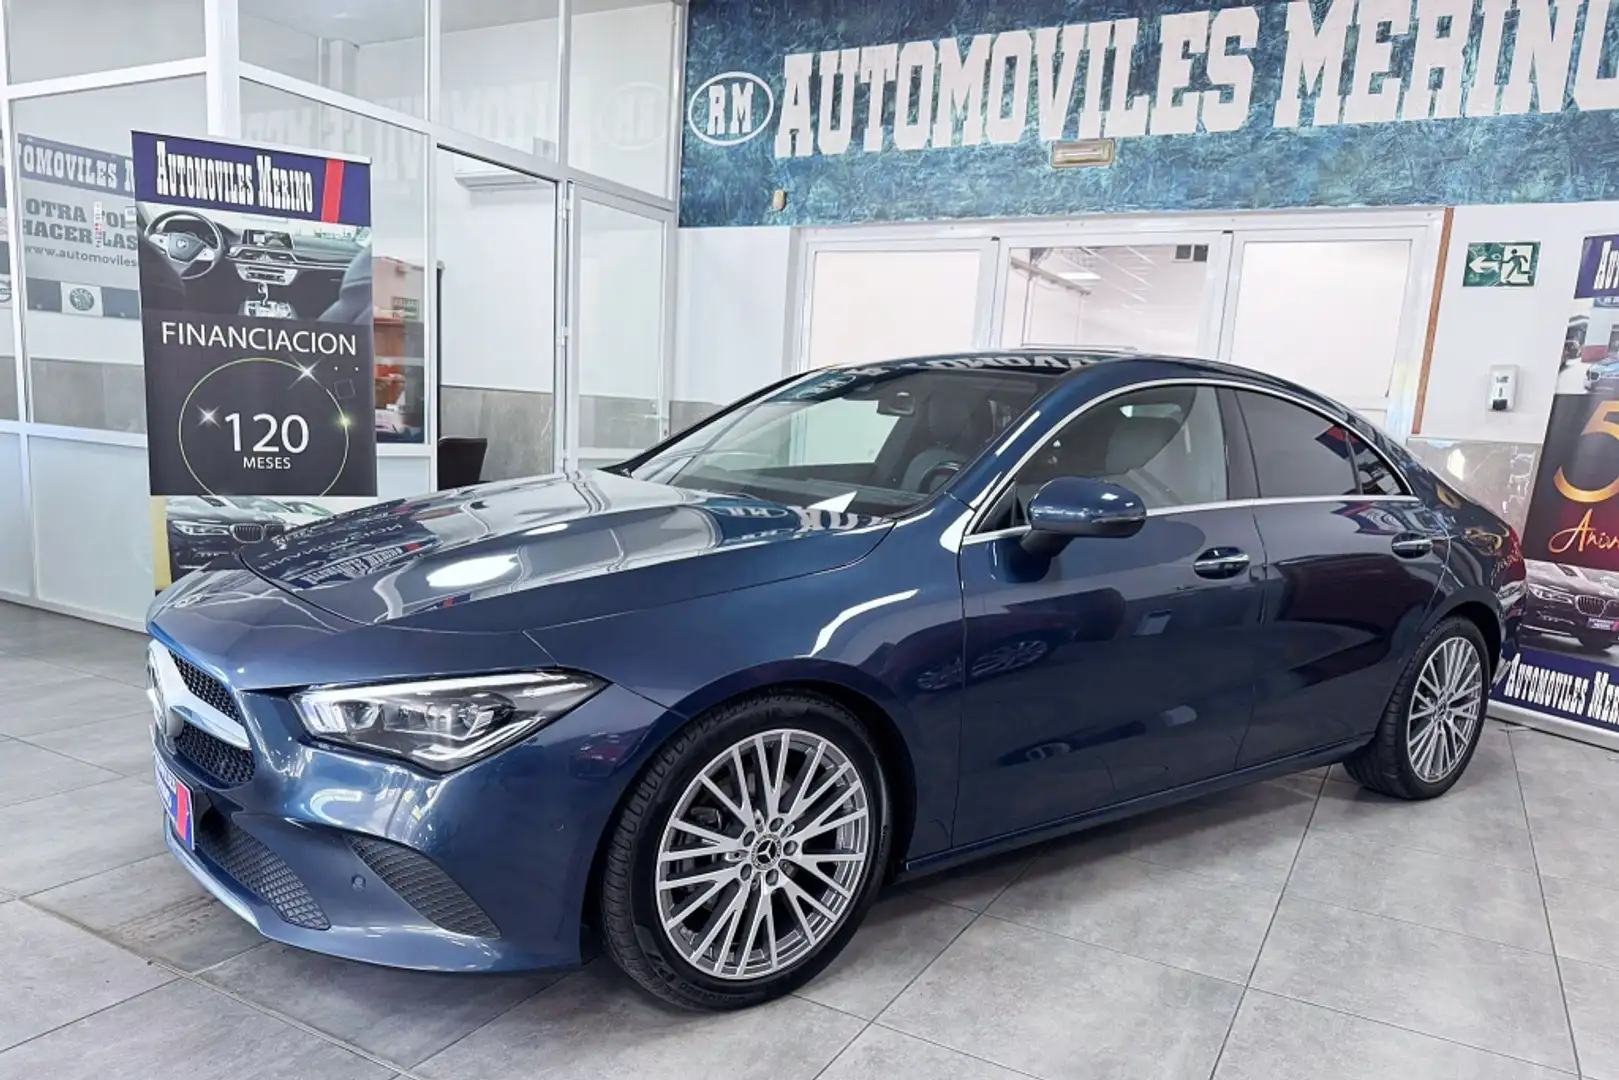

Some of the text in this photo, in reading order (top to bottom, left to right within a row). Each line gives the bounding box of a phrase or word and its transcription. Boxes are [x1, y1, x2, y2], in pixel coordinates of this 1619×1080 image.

[774, 7, 1260, 158] AUTOMOVILES
[1274, 0, 1619, 128] MERINO
[707, 81, 754, 136] RM
[156, 140, 254, 206] AUTOMOVILES
[257, 155, 313, 213] MERINO
[25, 198, 87, 223] OTRA
[161, 321, 357, 356] FINANCIACION
[224, 412, 309, 453] 120
[243, 456, 291, 469] MESES
